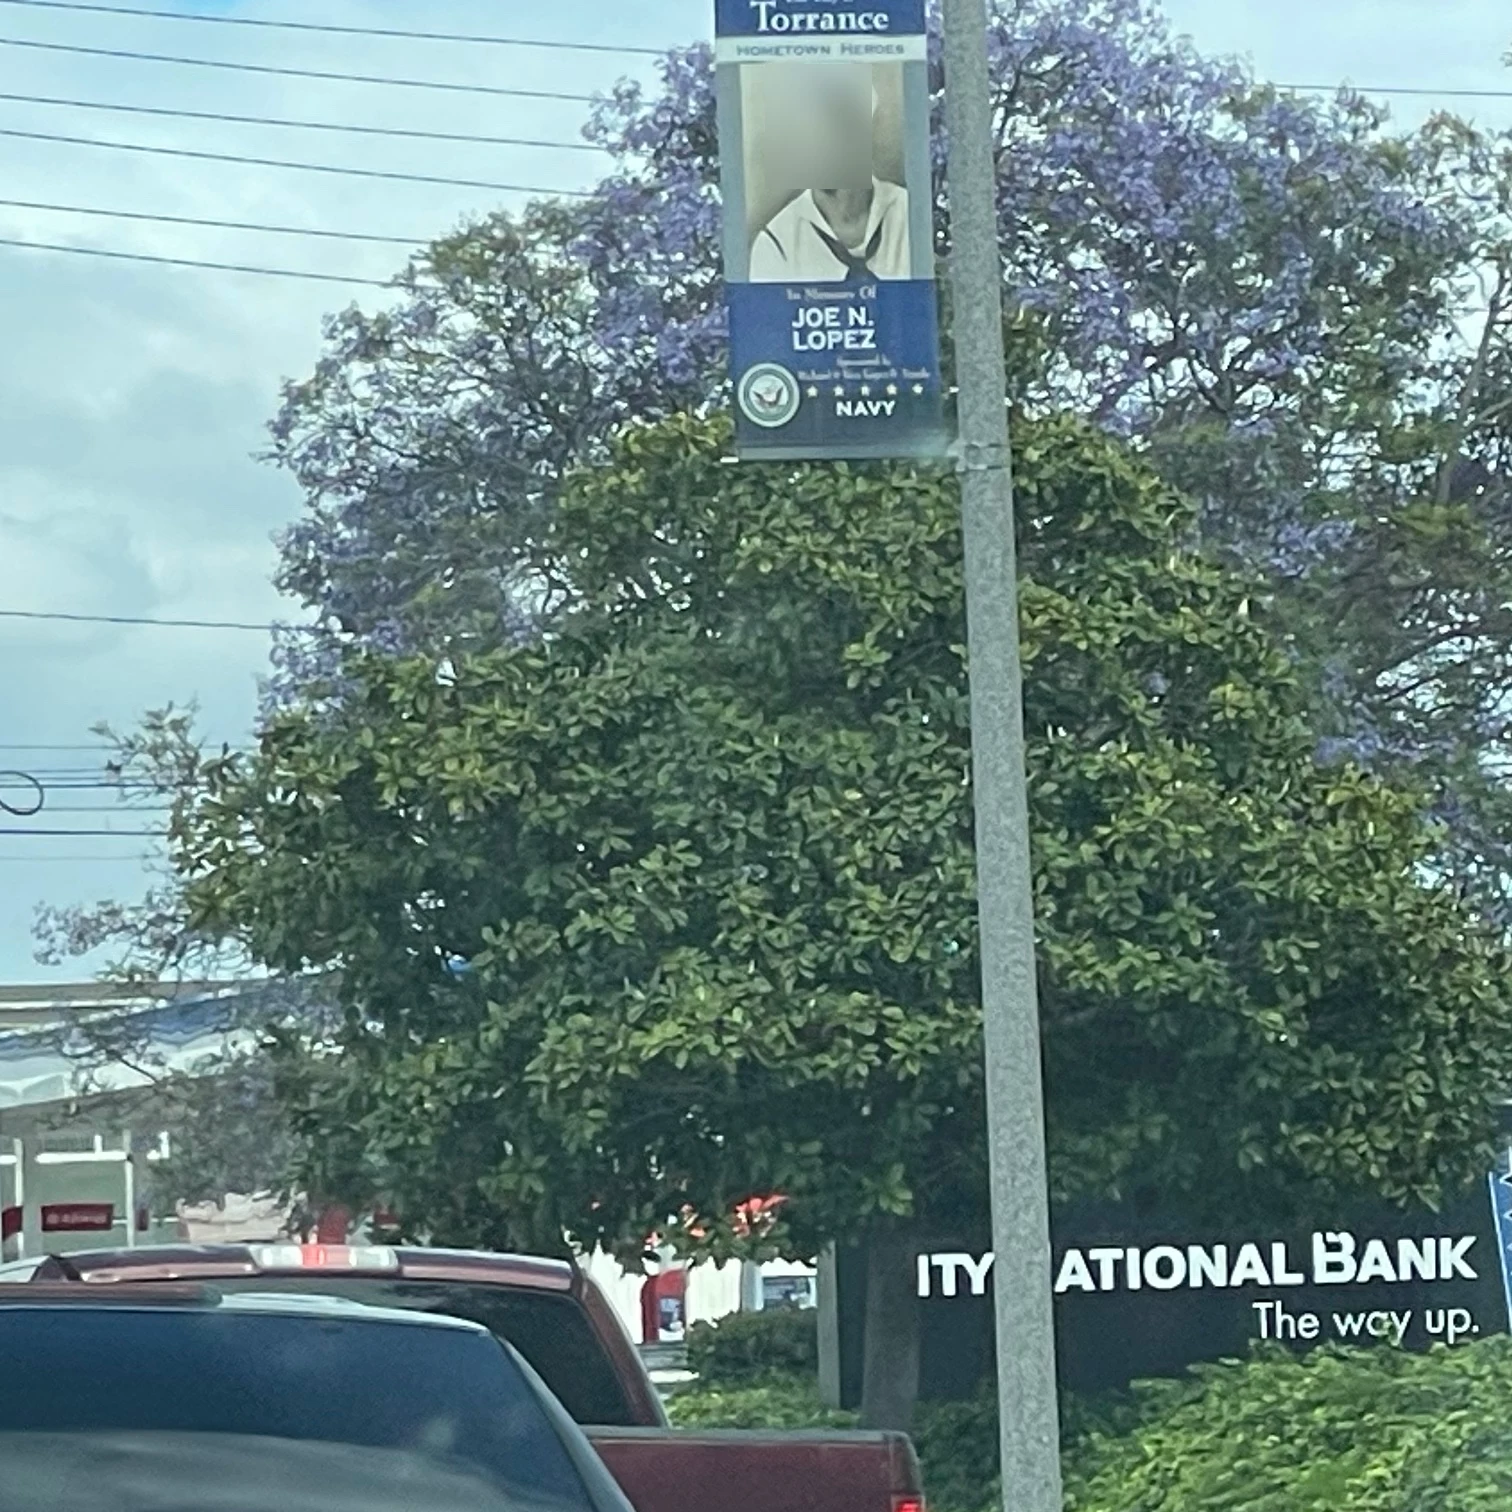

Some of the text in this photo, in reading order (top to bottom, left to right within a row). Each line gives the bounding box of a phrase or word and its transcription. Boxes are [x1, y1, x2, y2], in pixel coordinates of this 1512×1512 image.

[749, 1, 889, 31] Torrance
[737, 43, 905, 56] HOMETOWN HEROES
[791, 306, 875, 329] JOE N.
[792, 329, 877, 351] LOPEZ
[836, 400, 896, 417] NAVY
[916, 1231, 1479, 1298] ITY ATIONAL BANK
[1251, 1300, 1480, 1347] The way up.
